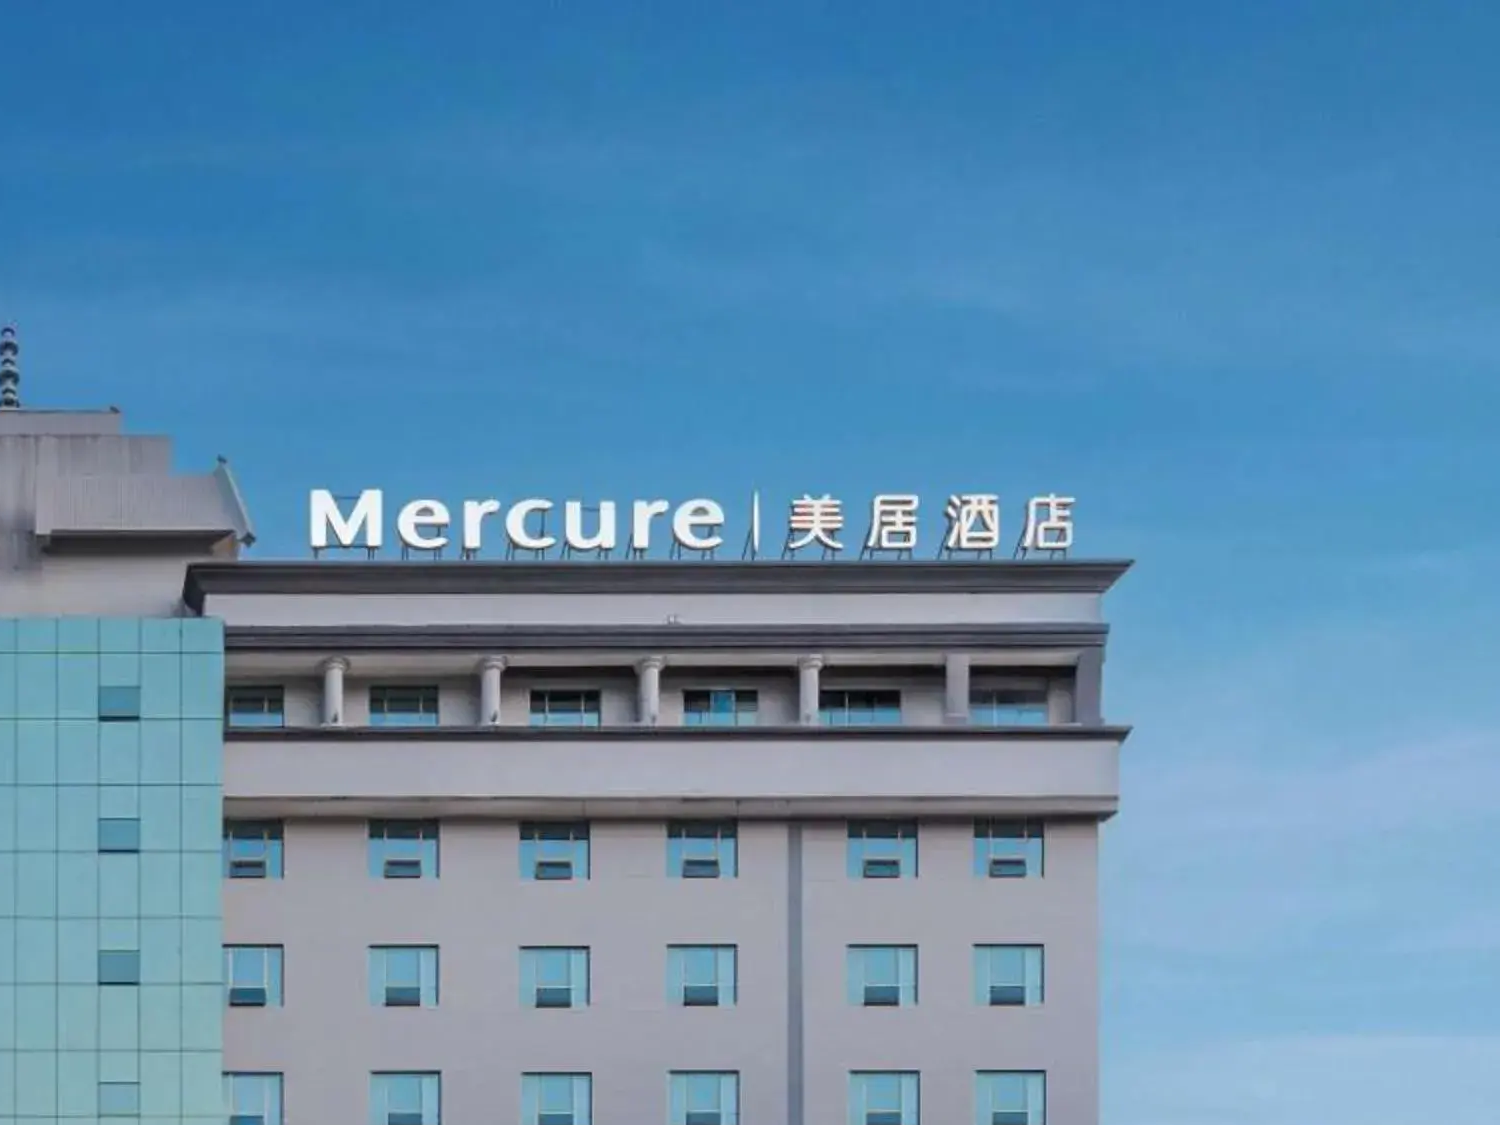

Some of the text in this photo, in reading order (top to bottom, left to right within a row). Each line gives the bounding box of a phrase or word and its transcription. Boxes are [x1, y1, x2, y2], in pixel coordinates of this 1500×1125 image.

[309, 488, 724, 549] Mercure
[788, 493, 1076, 550] 美居酒店
